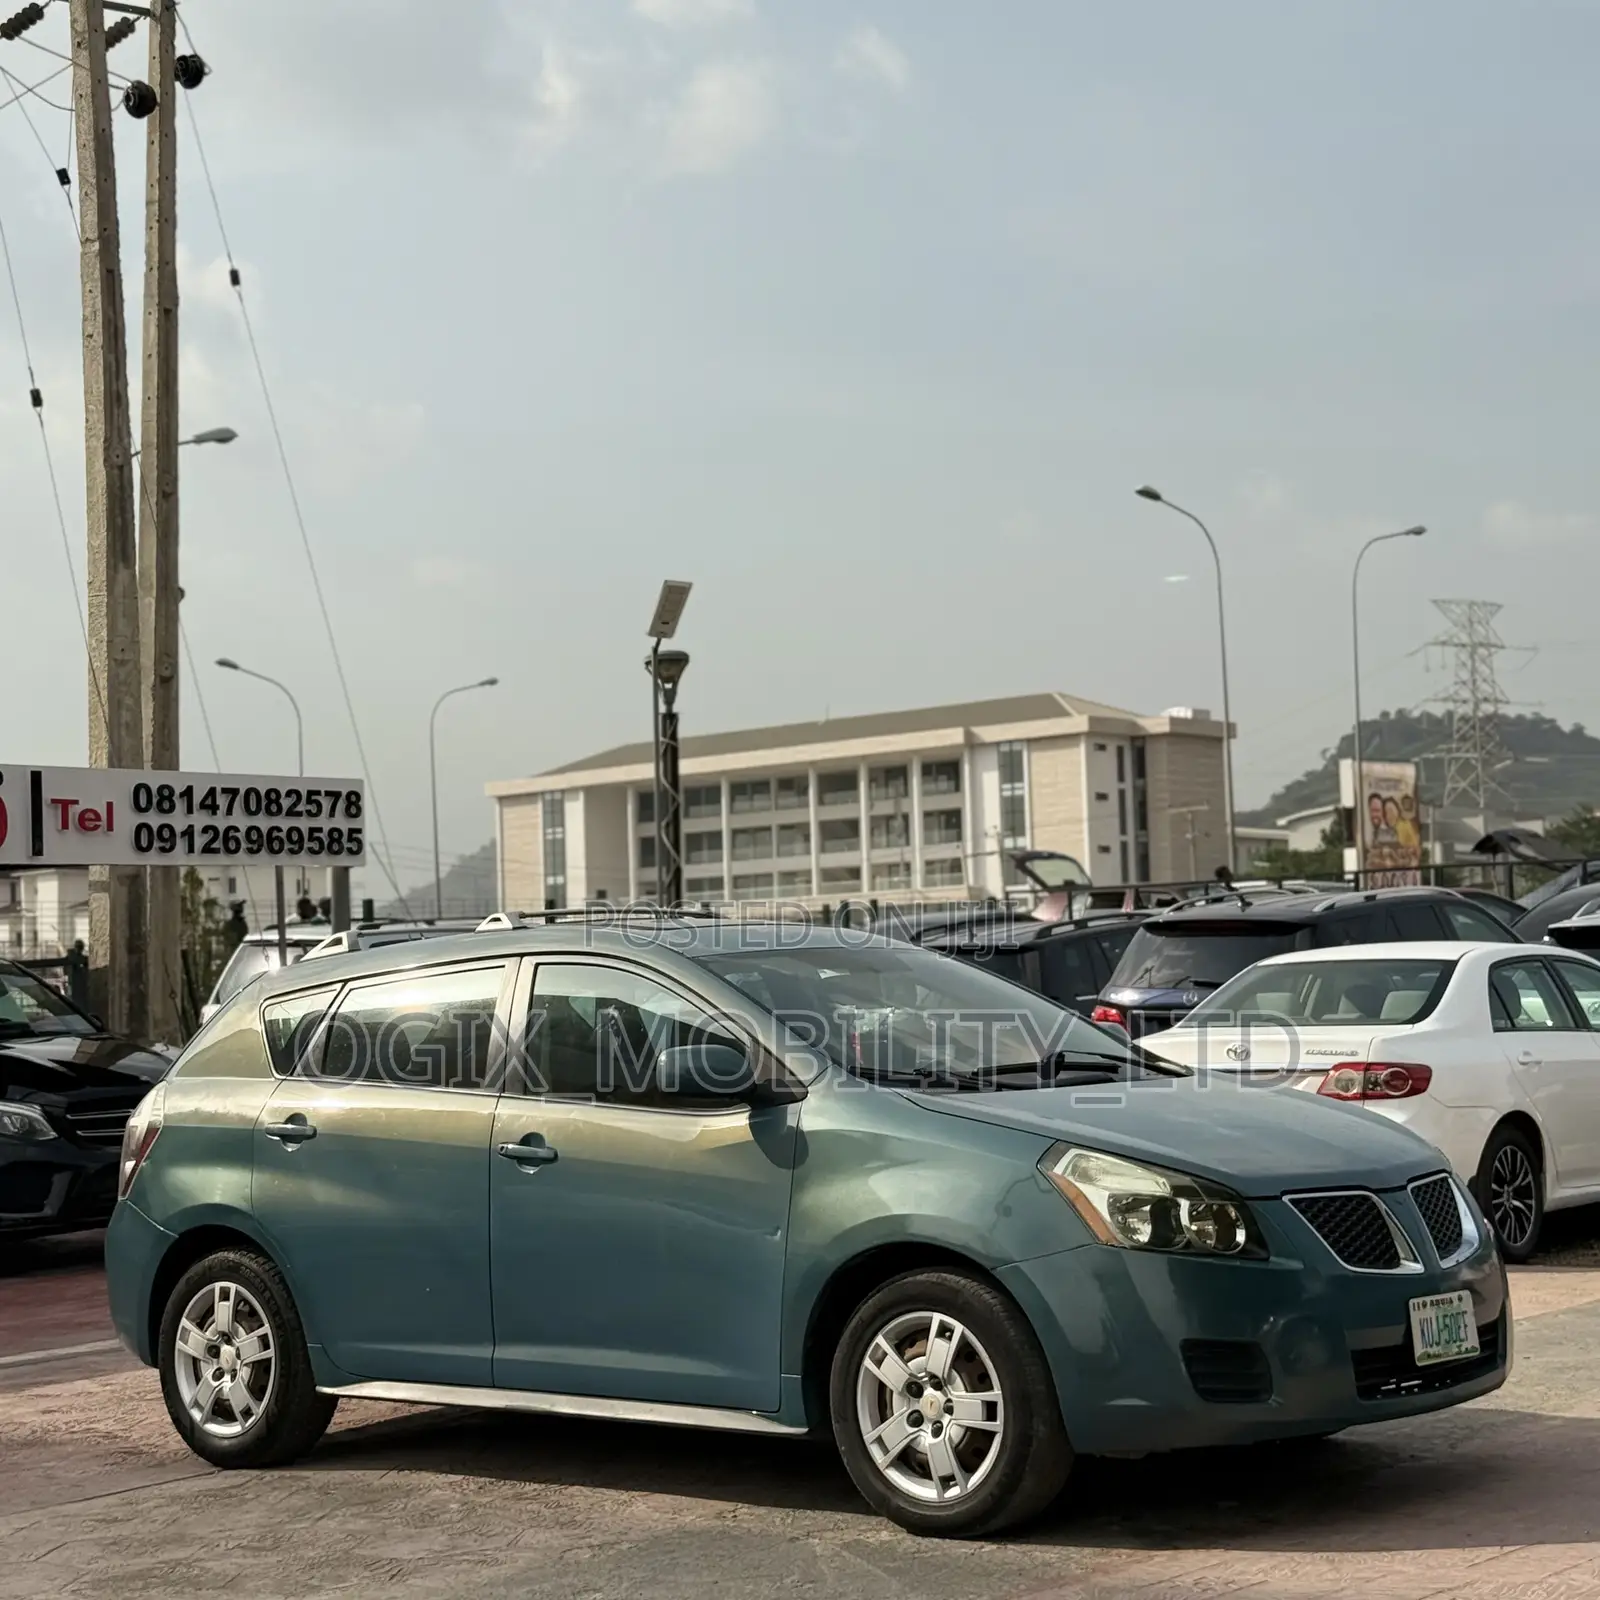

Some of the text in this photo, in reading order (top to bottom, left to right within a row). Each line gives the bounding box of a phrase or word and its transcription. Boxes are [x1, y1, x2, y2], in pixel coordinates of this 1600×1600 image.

[50, 797, 114, 832] Tel
[131, 782, 363, 820] 08147082578
[132, 821, 364, 856] 09126969585
